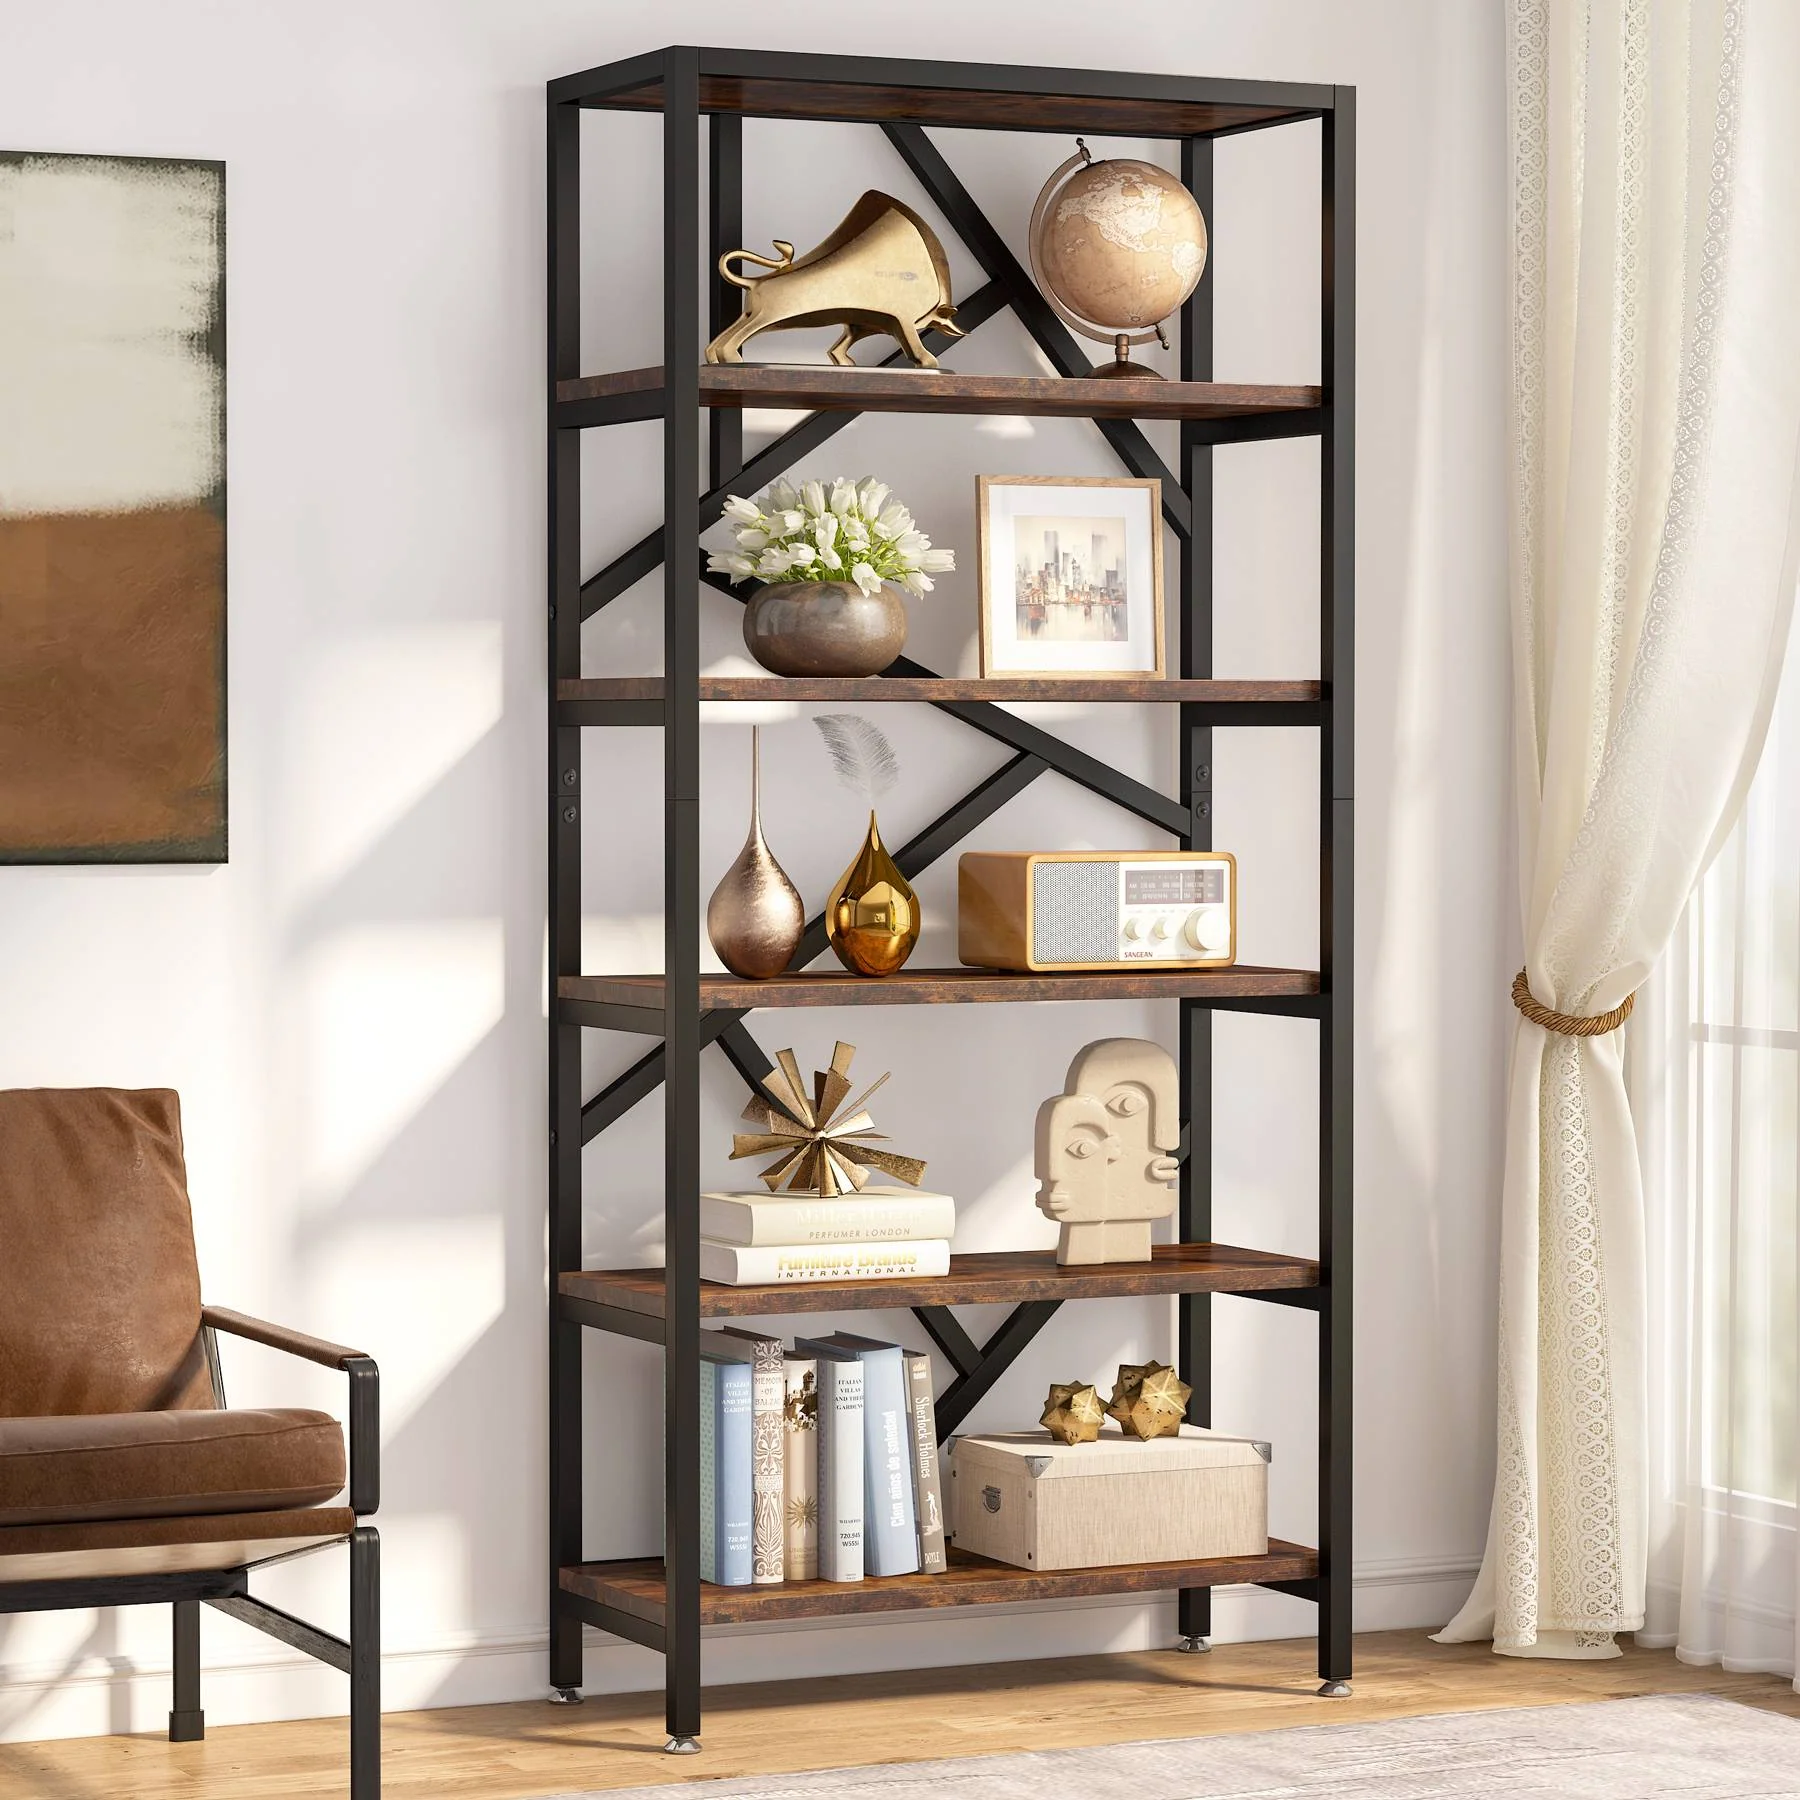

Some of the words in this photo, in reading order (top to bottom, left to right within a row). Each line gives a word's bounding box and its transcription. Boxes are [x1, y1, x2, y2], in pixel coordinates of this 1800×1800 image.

[809, 1231, 861, 1239] PERFUMER
[866, 1228, 911, 1237] LONDON
[777, 1253, 854, 1271] Furniture
[858, 1250, 918, 1267] Brands
[777, 1266, 916, 1278] INTERNATIONAL
[914, 1396, 932, 1441] Sherlock
[881, 1410, 900, 1455] soledad
[886, 1456, 901, 1471] de
[919, 1442, 935, 1479] Holmes
[887, 1472, 903, 1500] años
[890, 1502, 905, 1528] Cien
[924, 1551, 941, 1565] DOYLE
